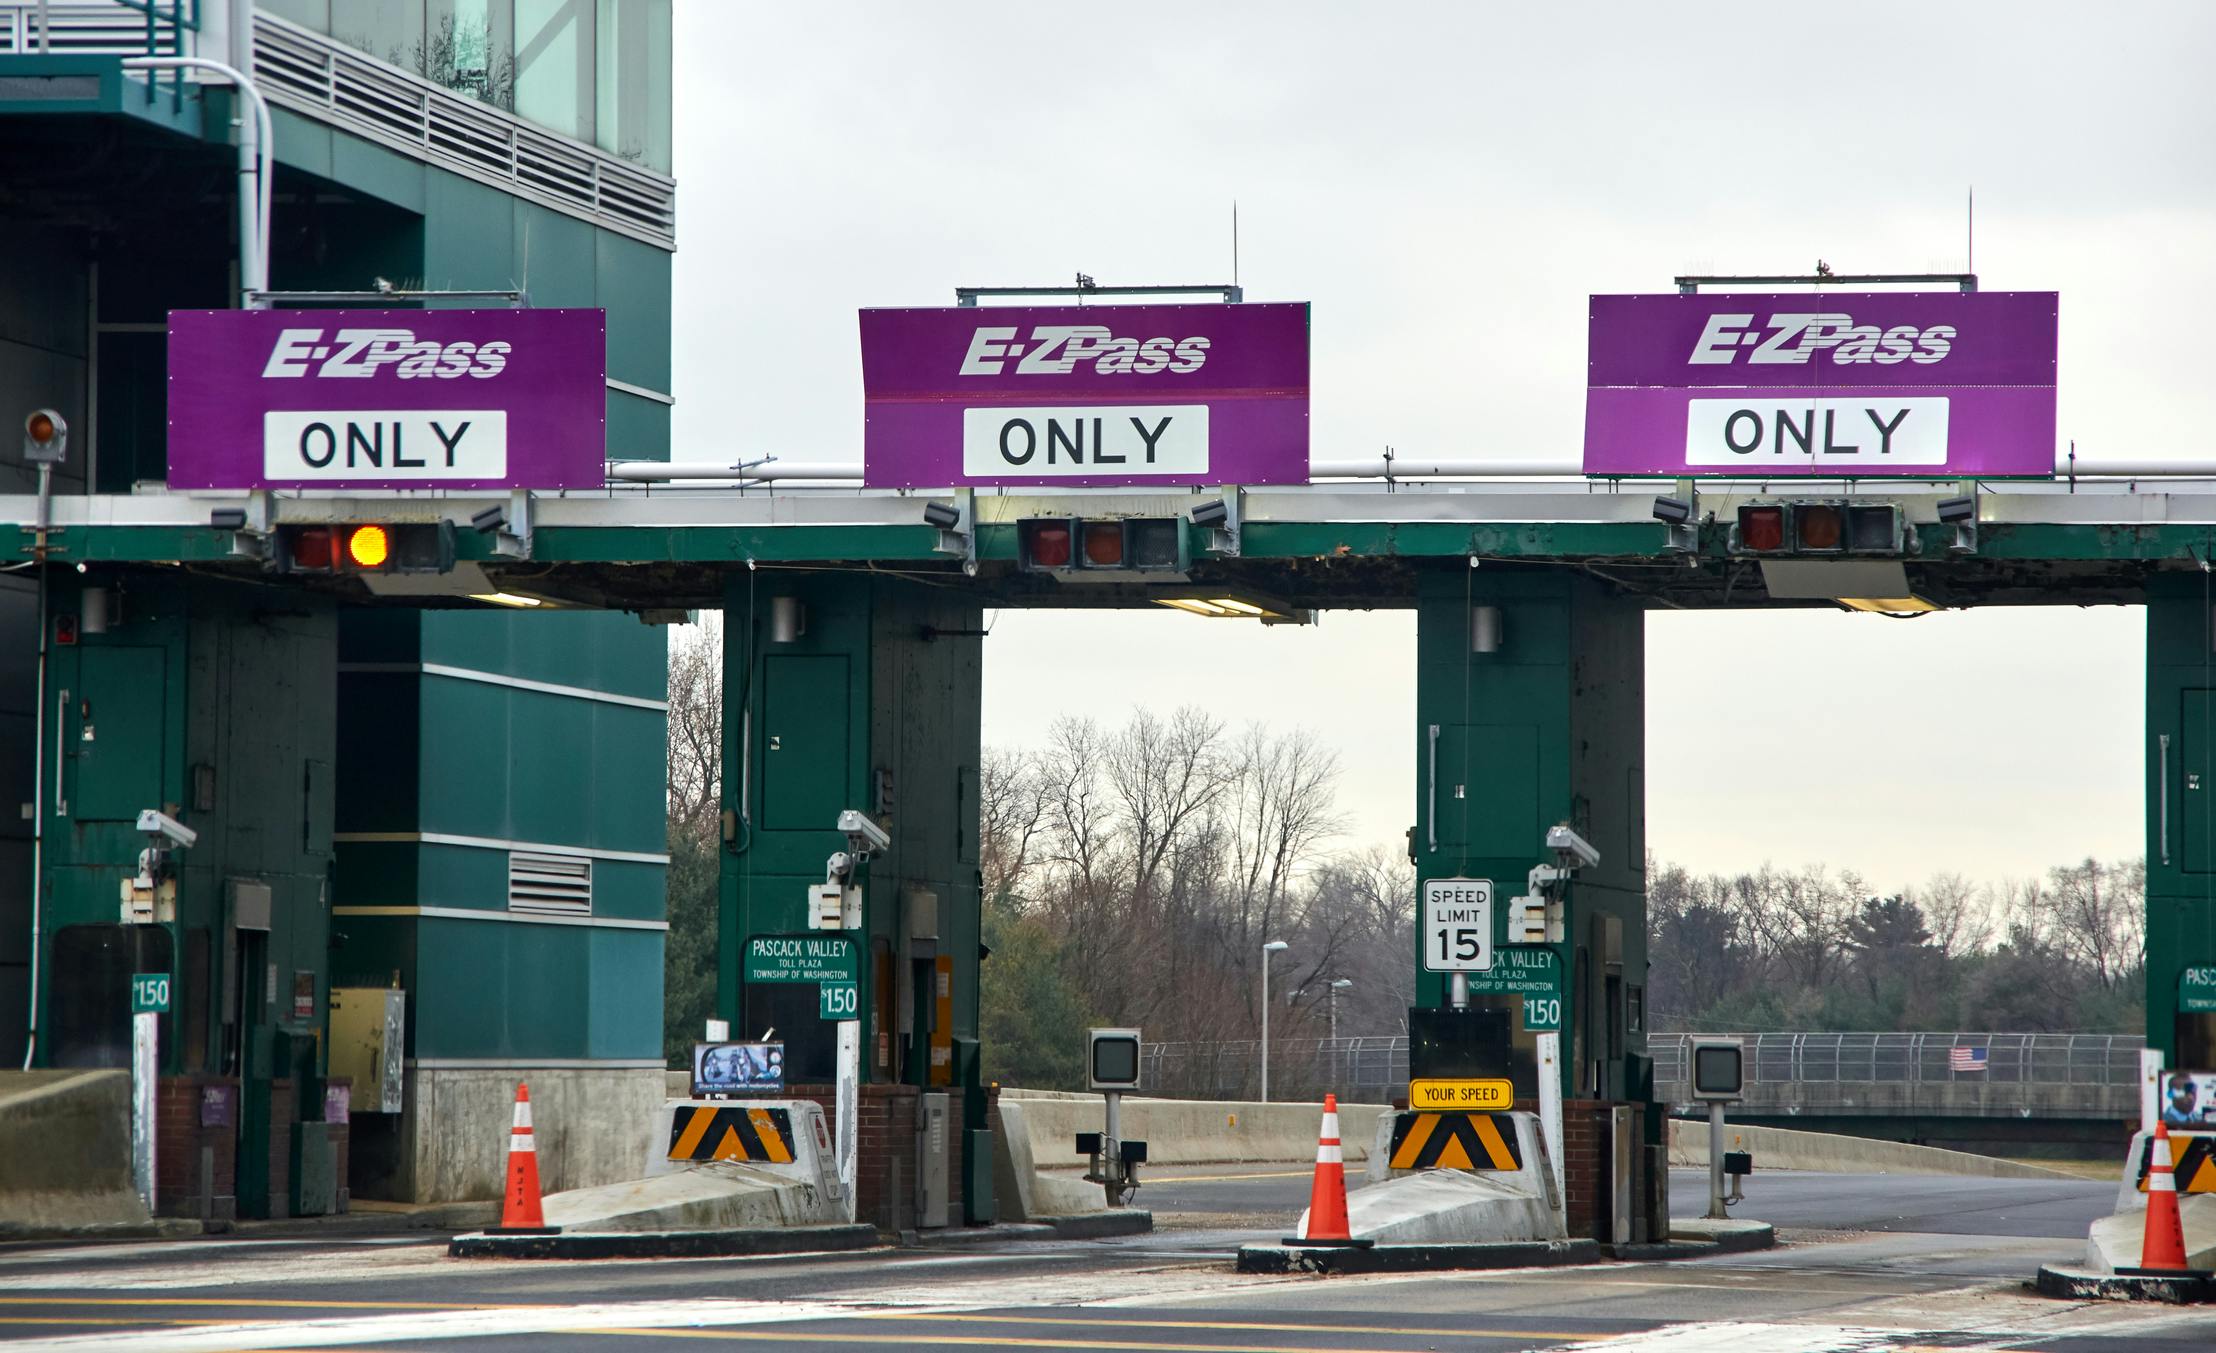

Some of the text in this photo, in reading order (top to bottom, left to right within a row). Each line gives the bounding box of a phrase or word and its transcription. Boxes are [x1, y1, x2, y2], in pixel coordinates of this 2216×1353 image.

[1687, 313, 1957, 364] E-ZPass
[261, 328, 512, 379] E-ZPass
[958, 325, 1211, 375] E-ZPass
[999, 416, 1173, 466] ONLY
[1724, 408, 1911, 455] ONLY
[299, 421, 472, 469] ONLY
[1431, 890, 1487, 903] SPEED
[1437, 910, 1480, 922] LIMIT
[753, 940, 848, 957] PASCACK VALLEY
[1438, 928, 1480, 961] 15
[779, 959, 822, 968] TOLL PLAZA
[1511, 951, 1553, 969] VALLEY
[753, 970, 848, 980] TOWNSHIP OF WASHINGTON
[1501, 970, 1527, 979] PLAZA
[1468, 981, 1553, 991] NSHIP OF WASHINGTON
[821, 988, 857, 1014] $1.50
[1524, 999, 1561, 1025] $1.50
[1424, 1088, 1499, 1101] YOUR SPEED
